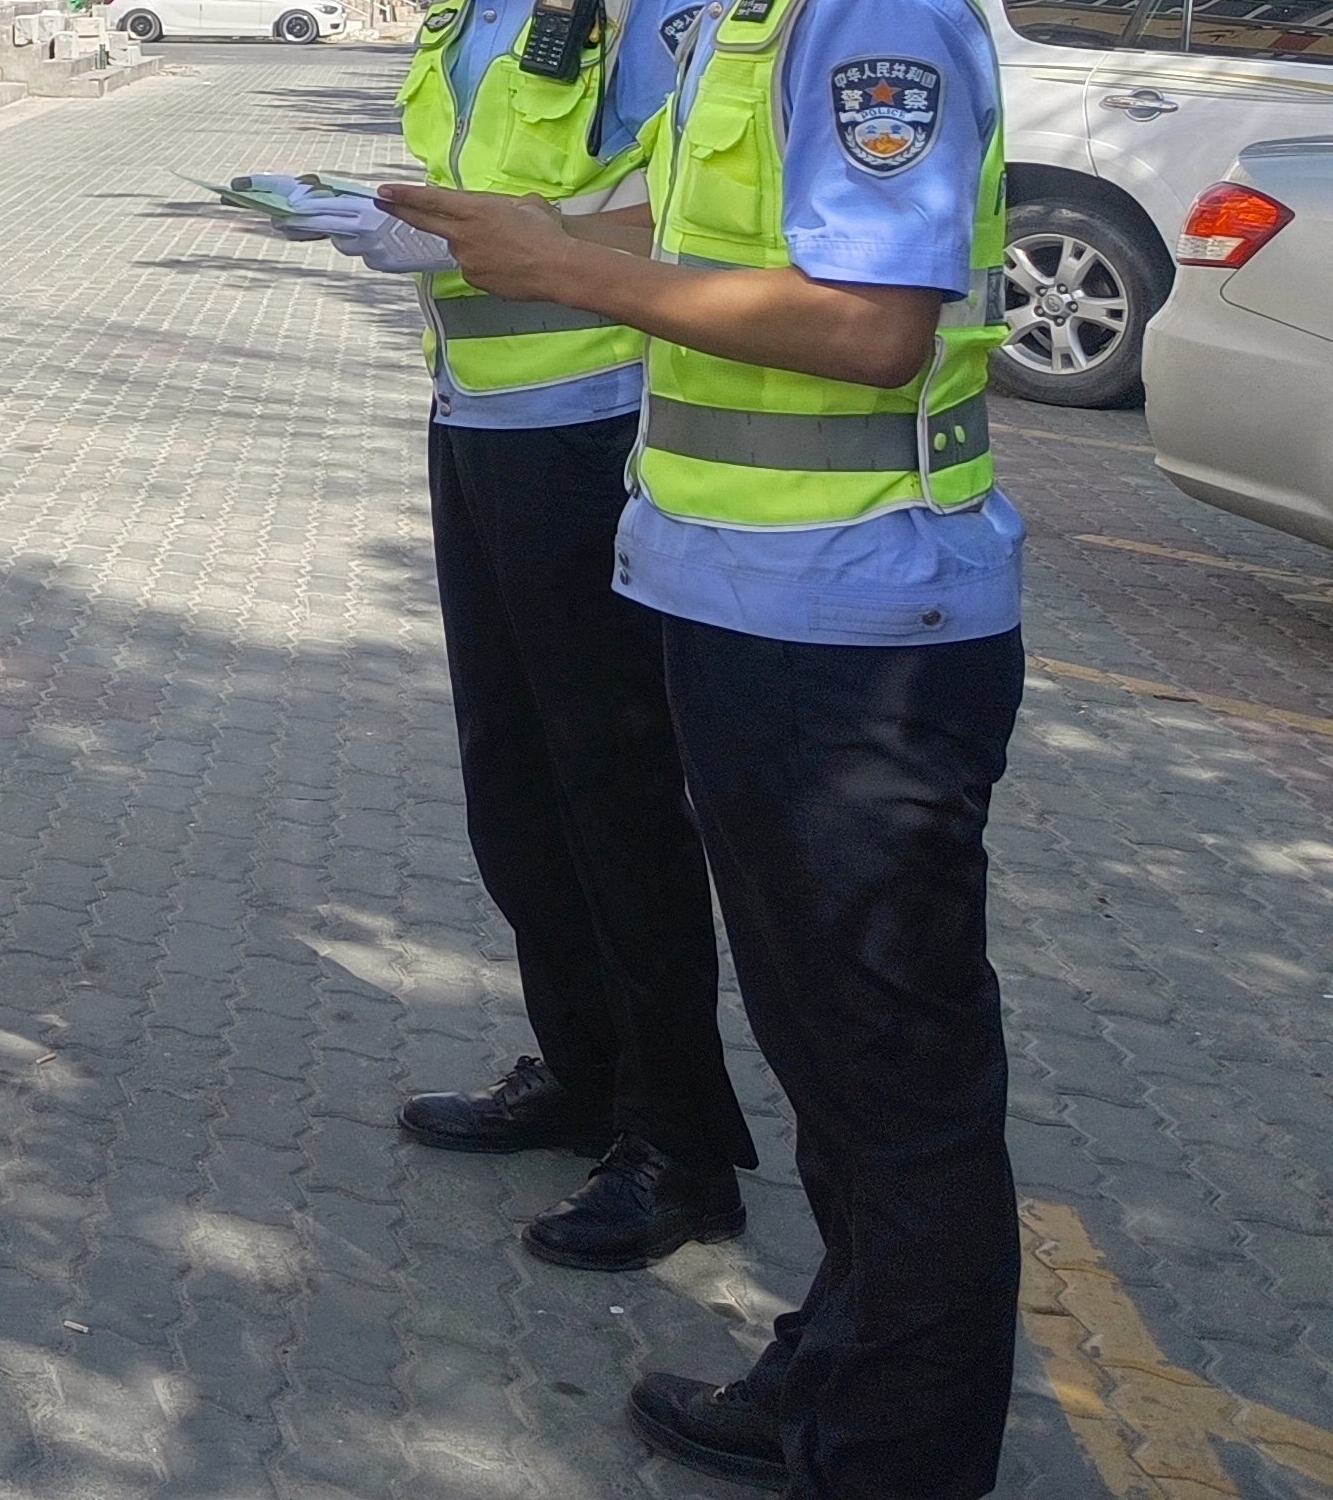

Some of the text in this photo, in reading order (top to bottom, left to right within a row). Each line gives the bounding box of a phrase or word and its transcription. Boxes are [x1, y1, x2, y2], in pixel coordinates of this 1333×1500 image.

[834, 61, 938, 89] 中华人民共和国
[861, 106, 907, 120] POLICE
